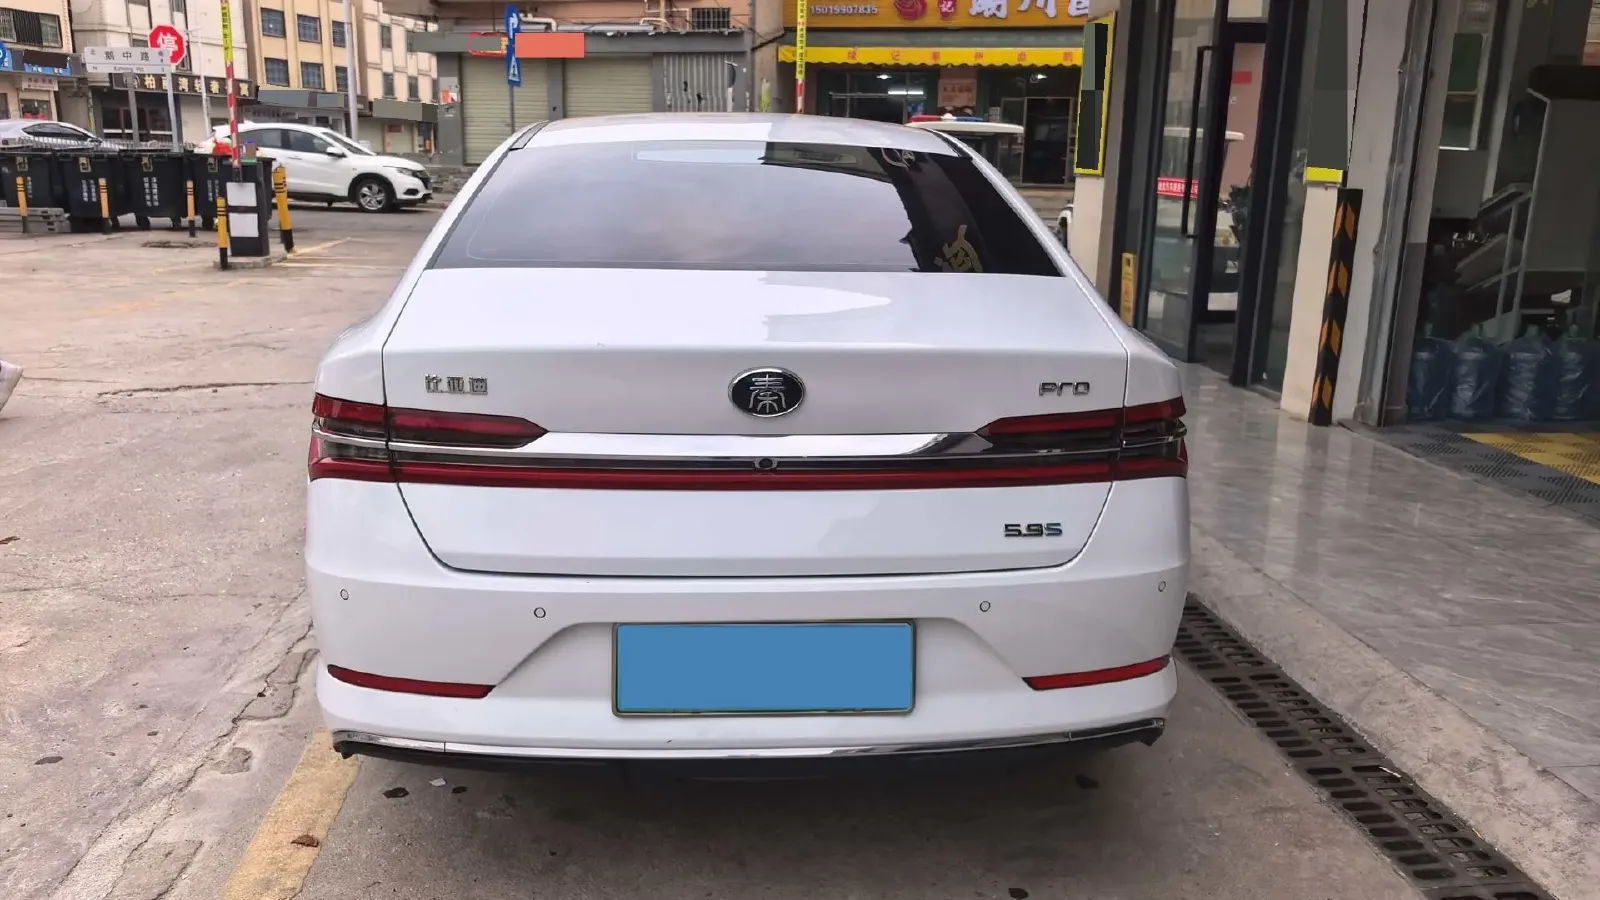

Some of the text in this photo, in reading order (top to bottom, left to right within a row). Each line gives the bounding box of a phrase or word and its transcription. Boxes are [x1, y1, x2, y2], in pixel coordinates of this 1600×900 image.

[157, 32, 178, 57] 停
[425, 374, 488, 395] 比亚迪
[749, 373, 787, 413] 秦
